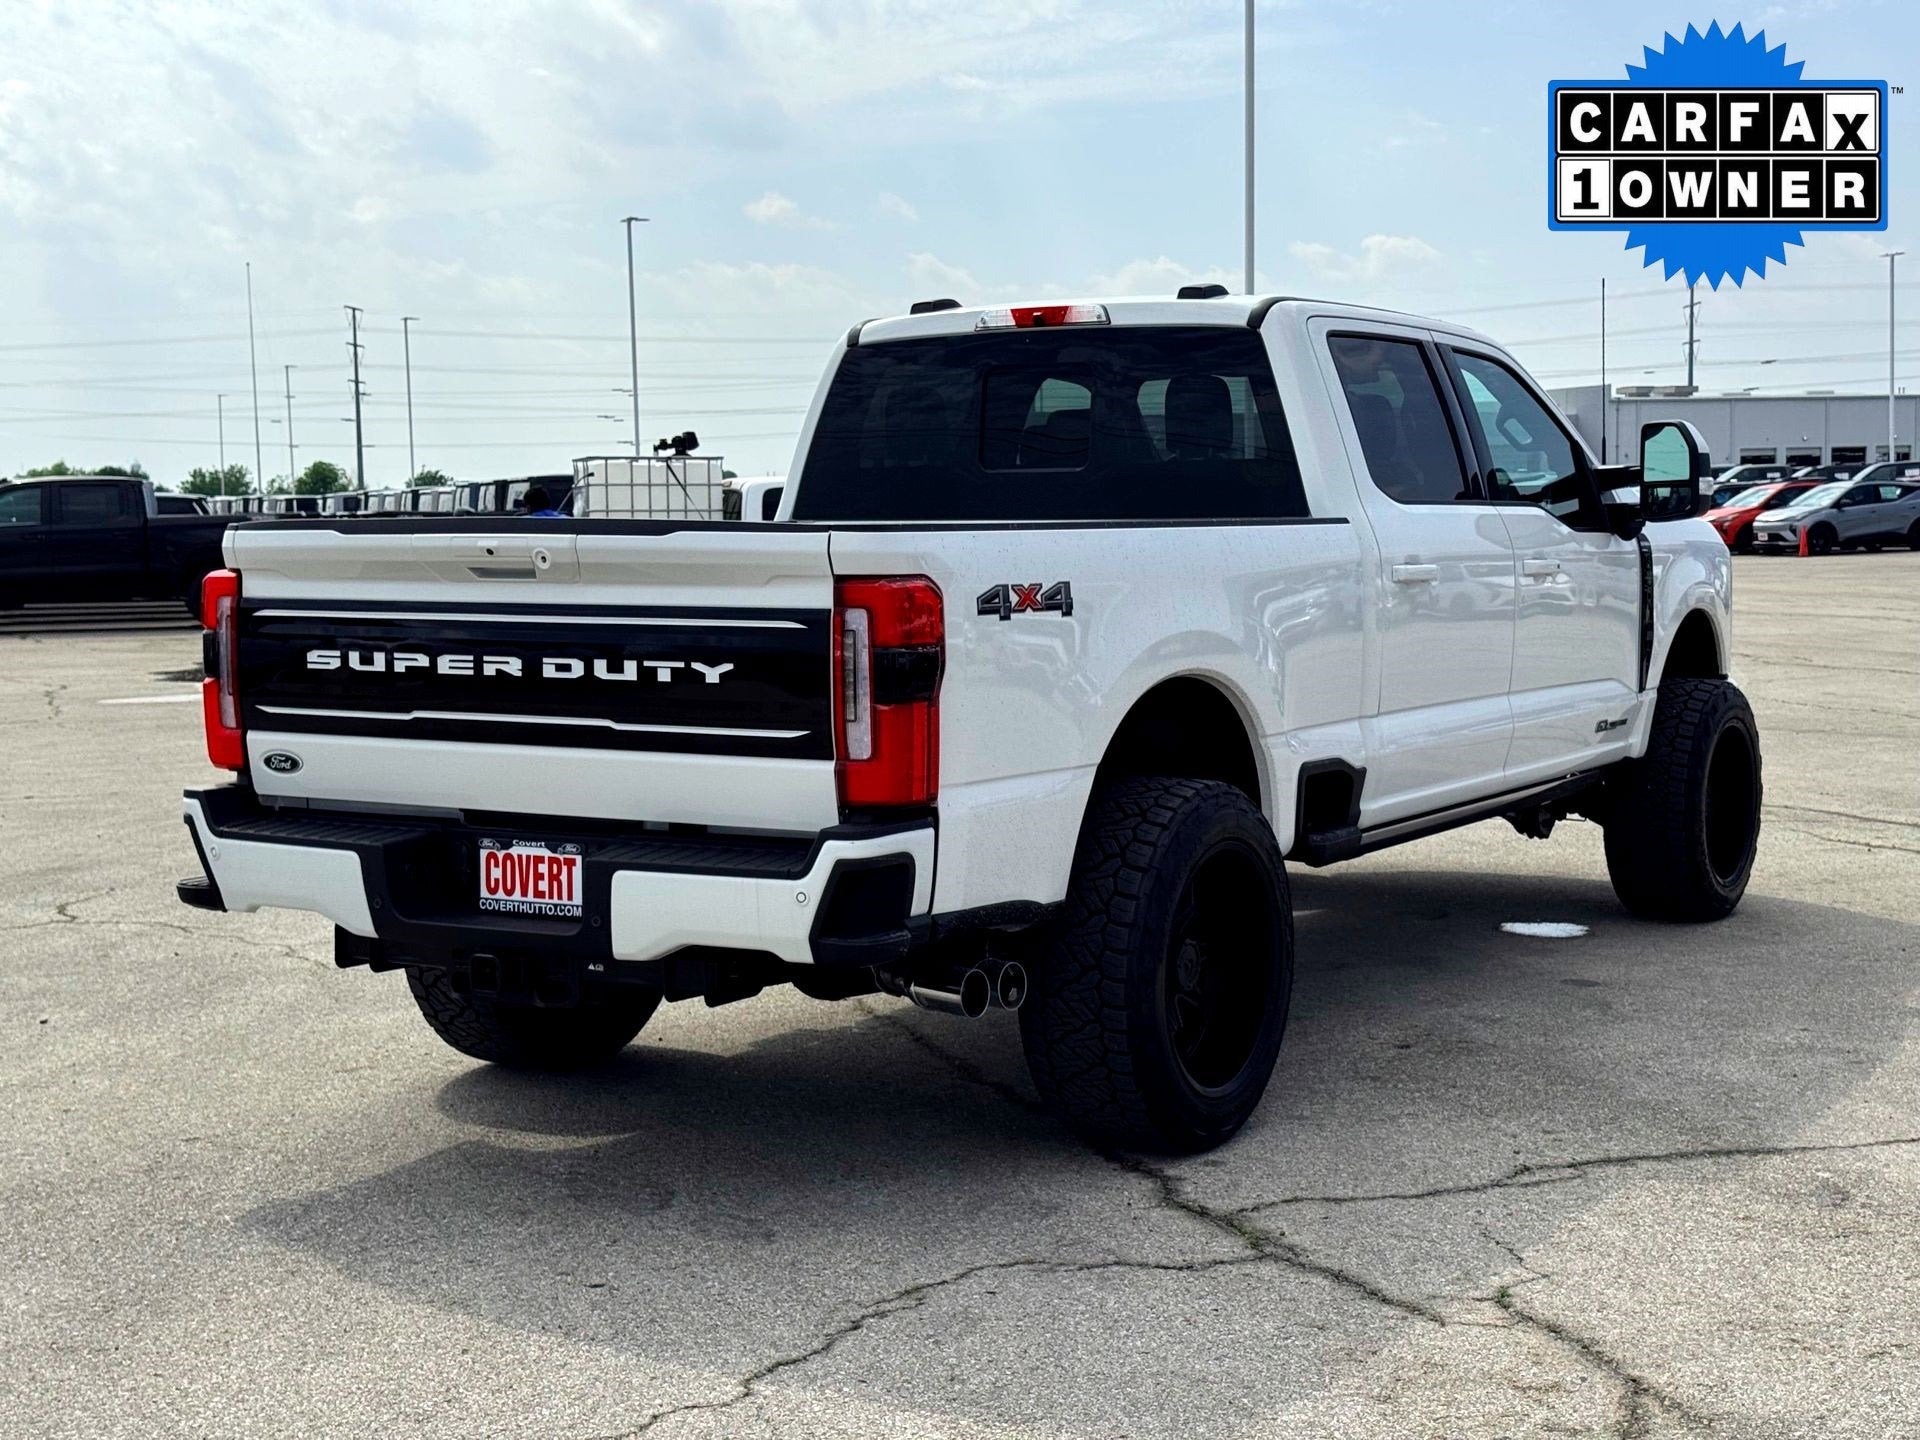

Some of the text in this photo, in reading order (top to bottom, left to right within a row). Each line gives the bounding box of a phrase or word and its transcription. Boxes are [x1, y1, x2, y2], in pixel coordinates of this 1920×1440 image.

[306, 648, 735, 684] SUPER DUTY
[270, 755, 292, 769] Ford
[512, 839, 546, 848] Covert
[484, 850, 578, 903] COVERT
[479, 898, 583, 918] COVERTHUTTO.COM
